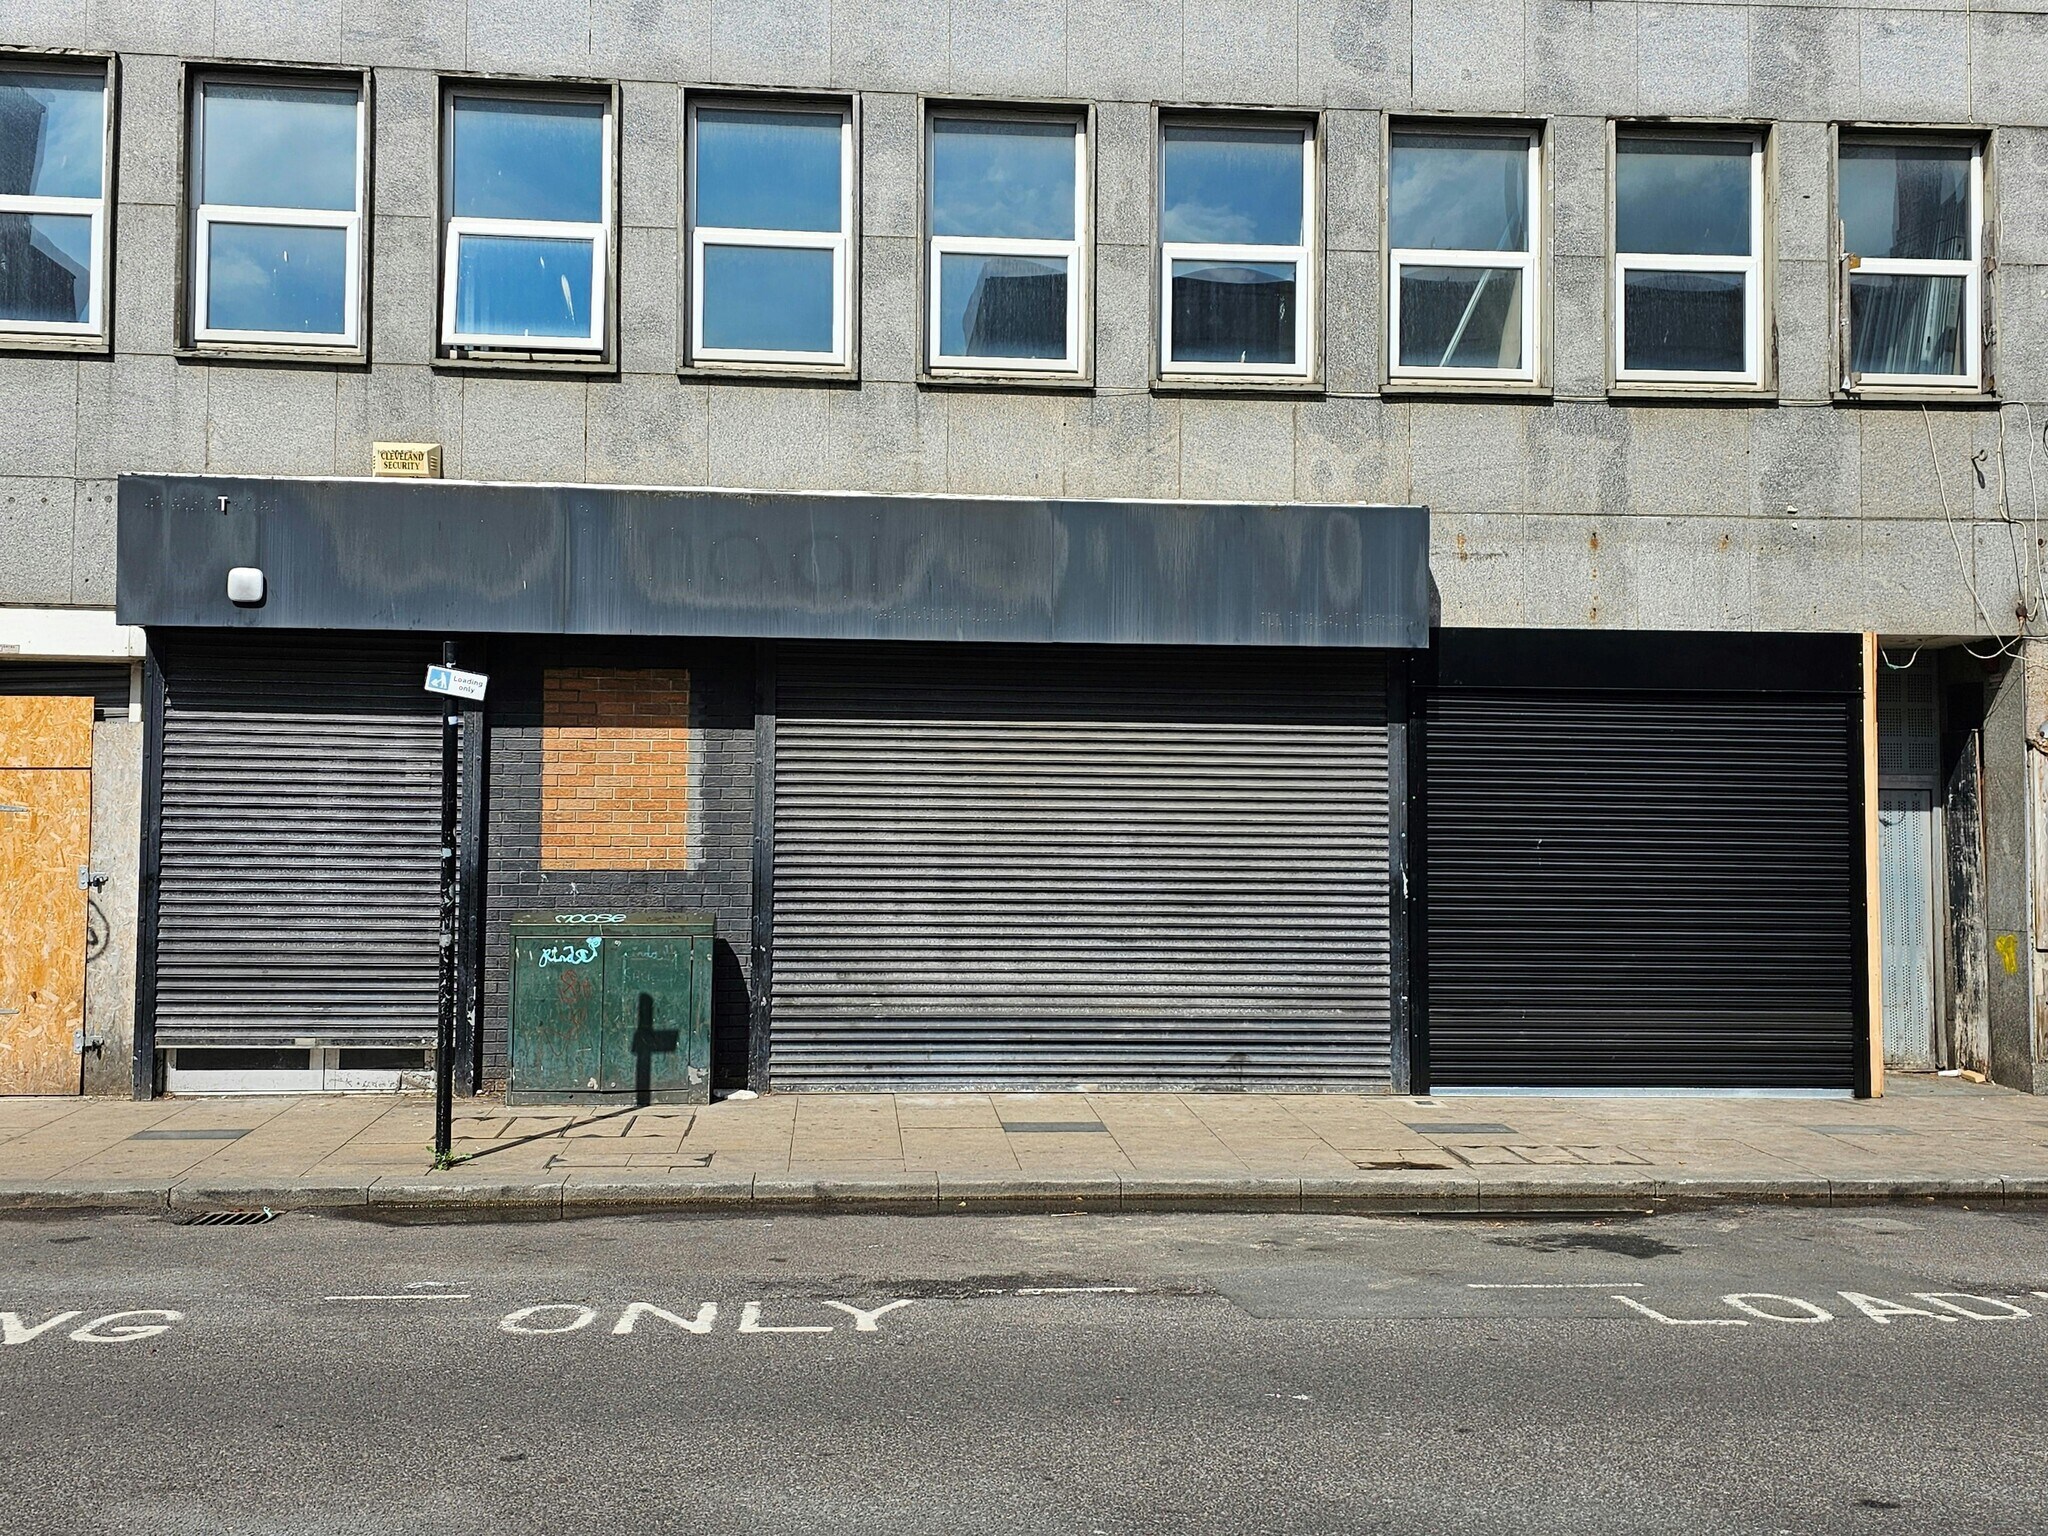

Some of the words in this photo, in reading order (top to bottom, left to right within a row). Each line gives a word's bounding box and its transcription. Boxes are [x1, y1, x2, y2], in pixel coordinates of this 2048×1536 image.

[380, 451, 424, 461] CLEVELAND
[383, 461, 419, 470] SECURITY
[217, 495, 229, 512] T
[453, 675, 484, 688] Loading
[458, 685, 475, 694] only
[1610, 1291, 2048, 1325] LOAD
[498, 1301, 914, 1334] ONLY
